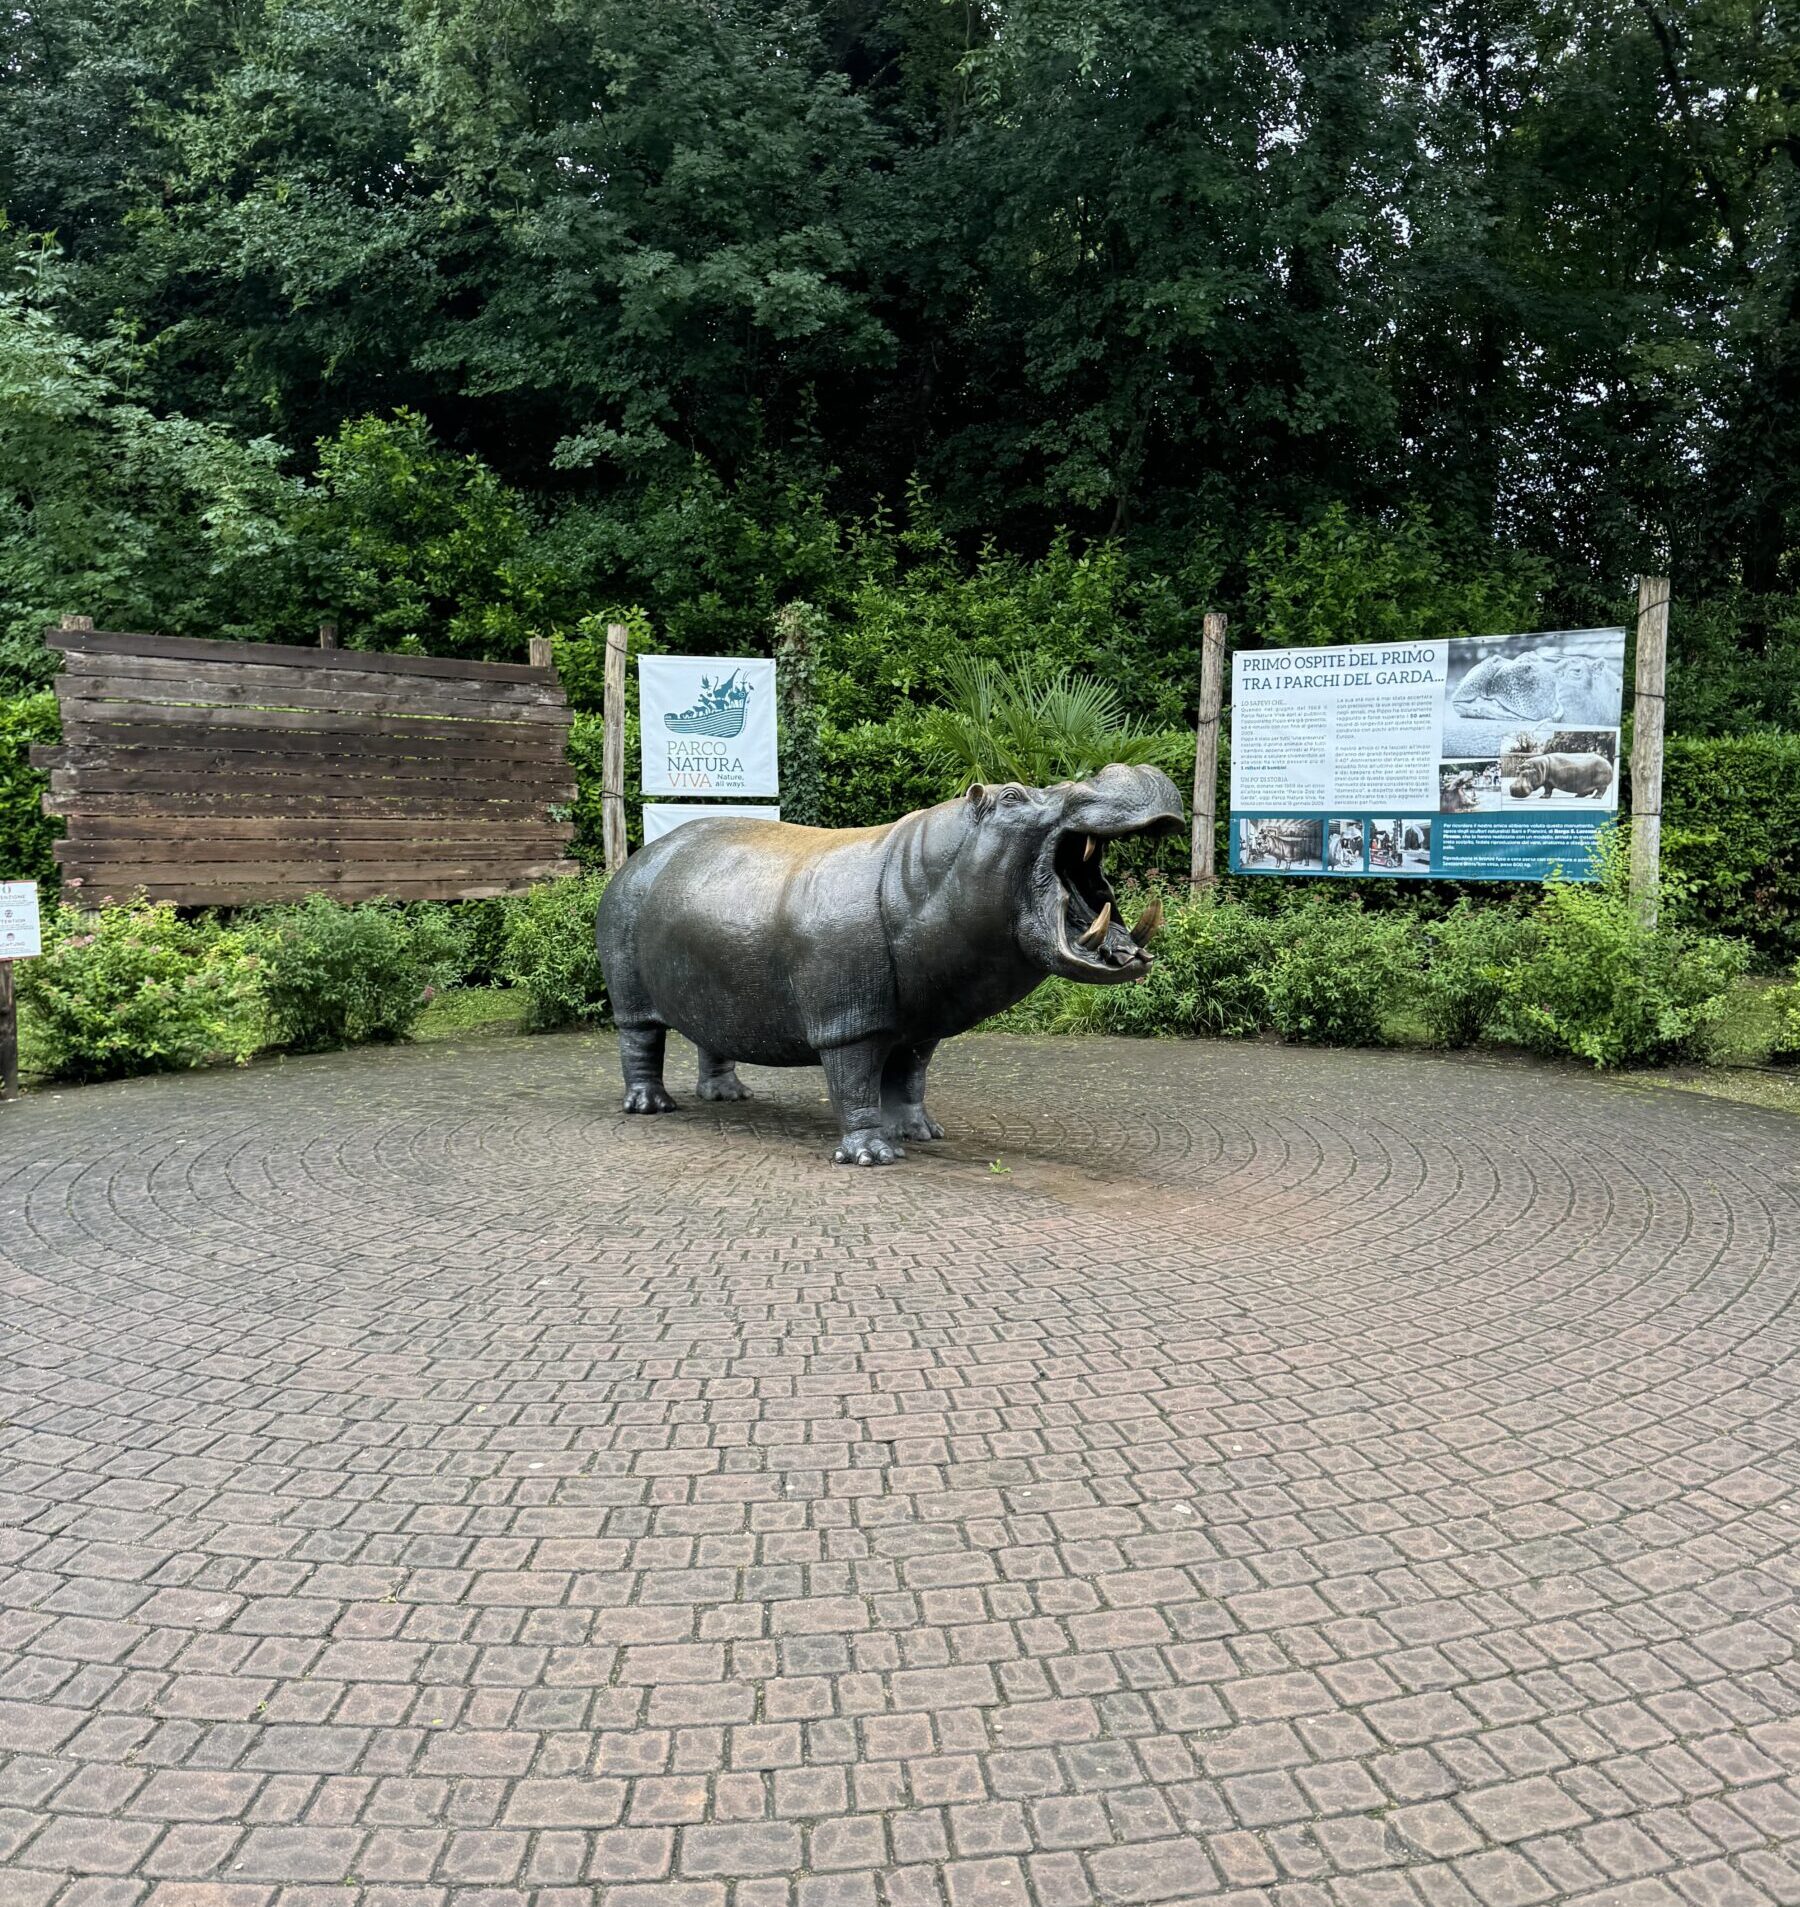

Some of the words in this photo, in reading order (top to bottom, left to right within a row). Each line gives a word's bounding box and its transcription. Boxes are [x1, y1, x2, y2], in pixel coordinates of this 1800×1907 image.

[1243, 658, 1291, 671] PRIMO
[1295, 655, 1346, 669] OSPITE
[1349, 653, 1378, 666] DEL
[1382, 650, 1435, 665] PRIMO
[1242, 678, 1272, 690] TRA
[1276, 677, 1280, 689] I
[1284, 674, 1340, 689] PARCHI
[1344, 673, 1372, 686] DEL
[1376, 670, 1444, 685] GARDA...
[667, 741, 727, 756] PARCO
[667, 757, 744, 772] NATURA
[668, 773, 712, 788] VIVA
